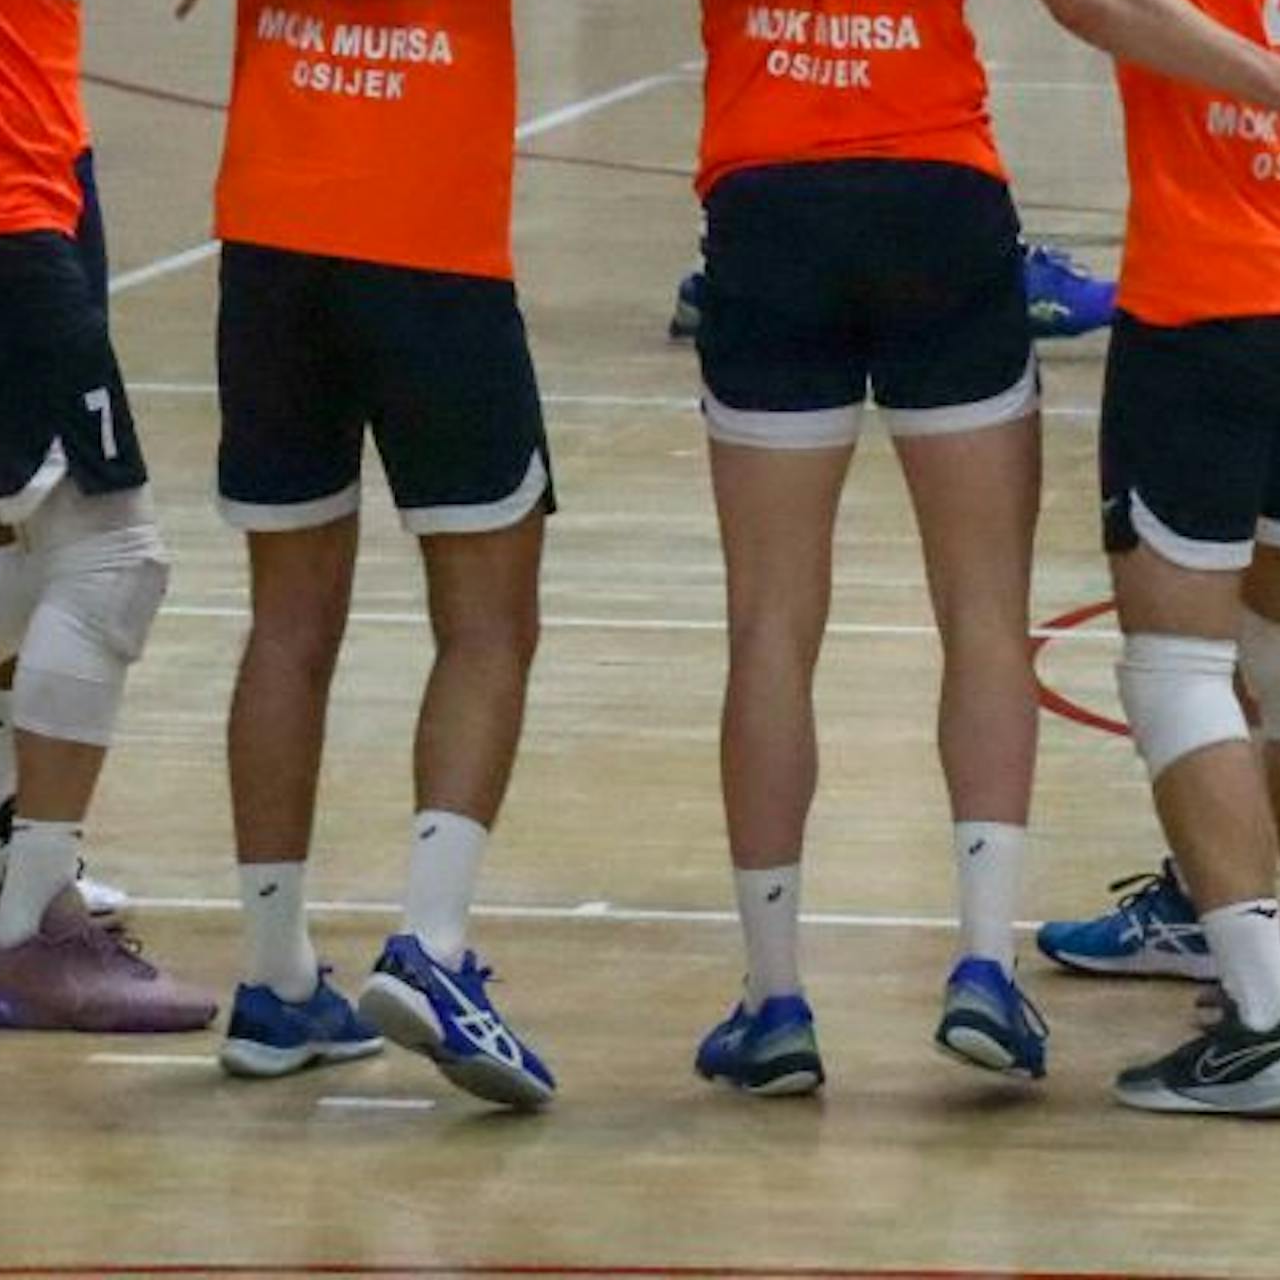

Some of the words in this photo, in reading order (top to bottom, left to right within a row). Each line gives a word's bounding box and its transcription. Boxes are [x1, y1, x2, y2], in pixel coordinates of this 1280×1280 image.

[331, 22, 454, 66] MURSA
[291, 57, 406, 101] OSIJEK
[766, 48, 871, 90] OSIJEK
[83, 386, 119, 460] 7
